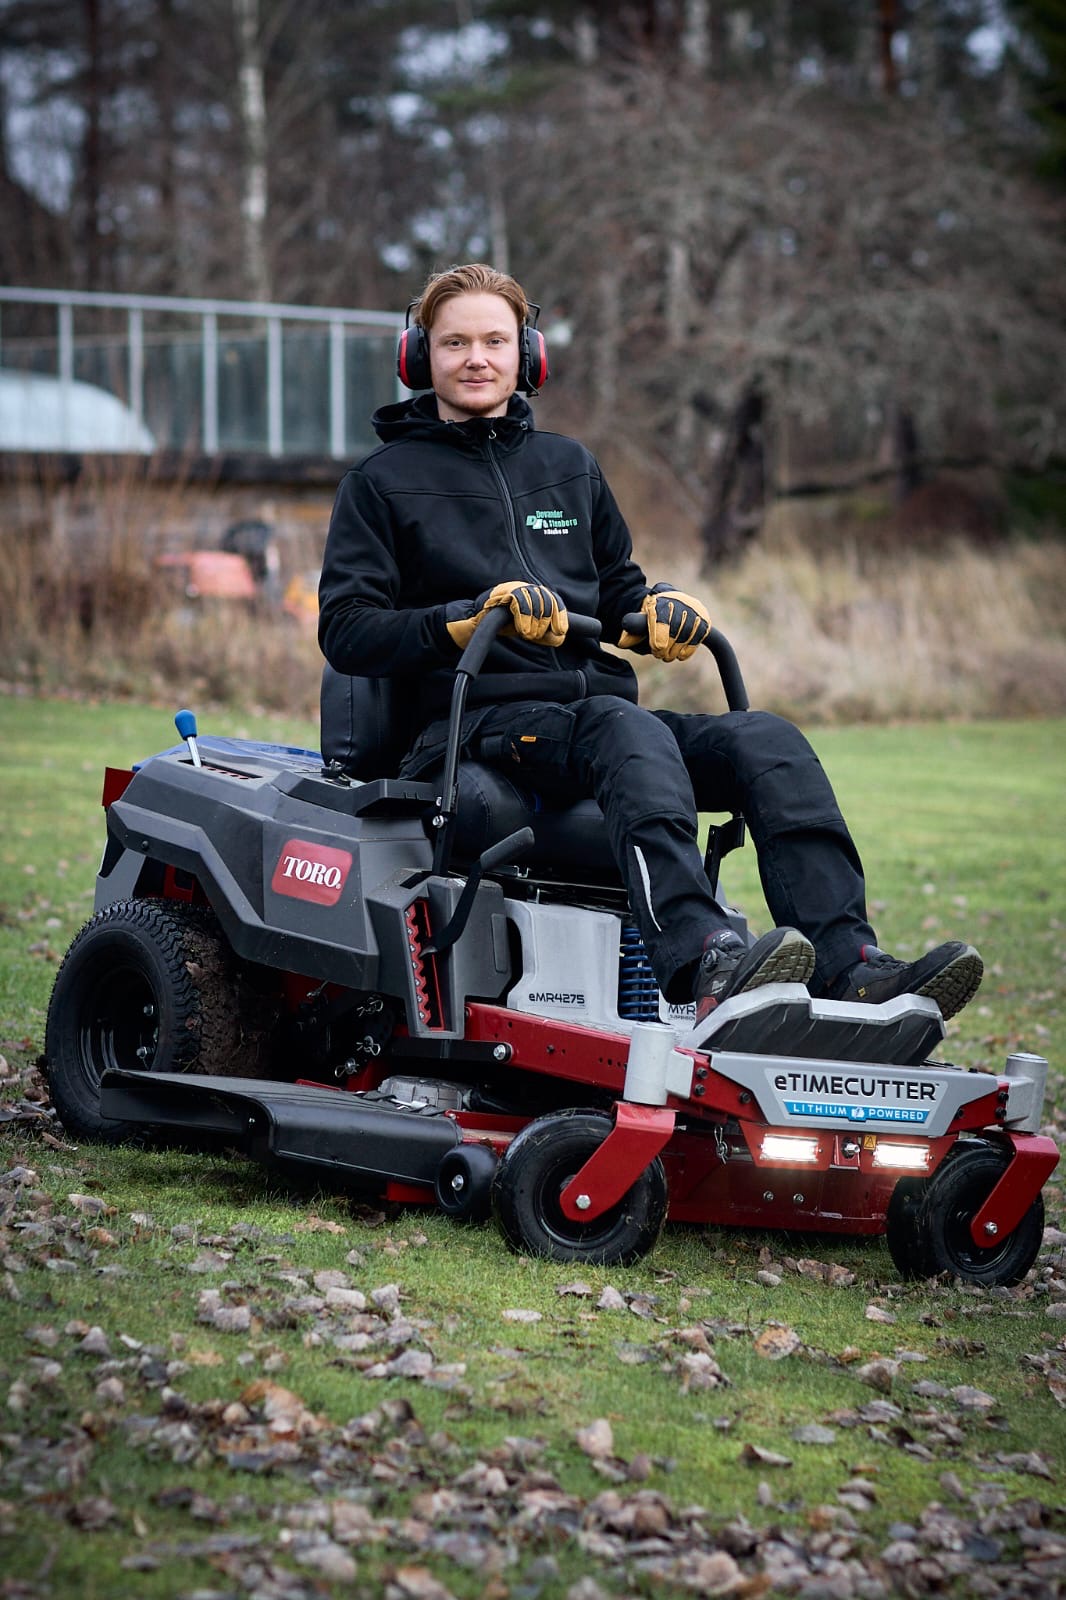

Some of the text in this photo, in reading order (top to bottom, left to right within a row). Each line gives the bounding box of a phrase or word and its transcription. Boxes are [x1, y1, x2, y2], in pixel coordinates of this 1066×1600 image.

[283, 856, 341, 889] TORO
[528, 992, 585, 1004] eMR4275
[774, 1073, 937, 1101] eTIMECUTTER
[793, 1104, 924, 1120] LITHIUM POWERED
